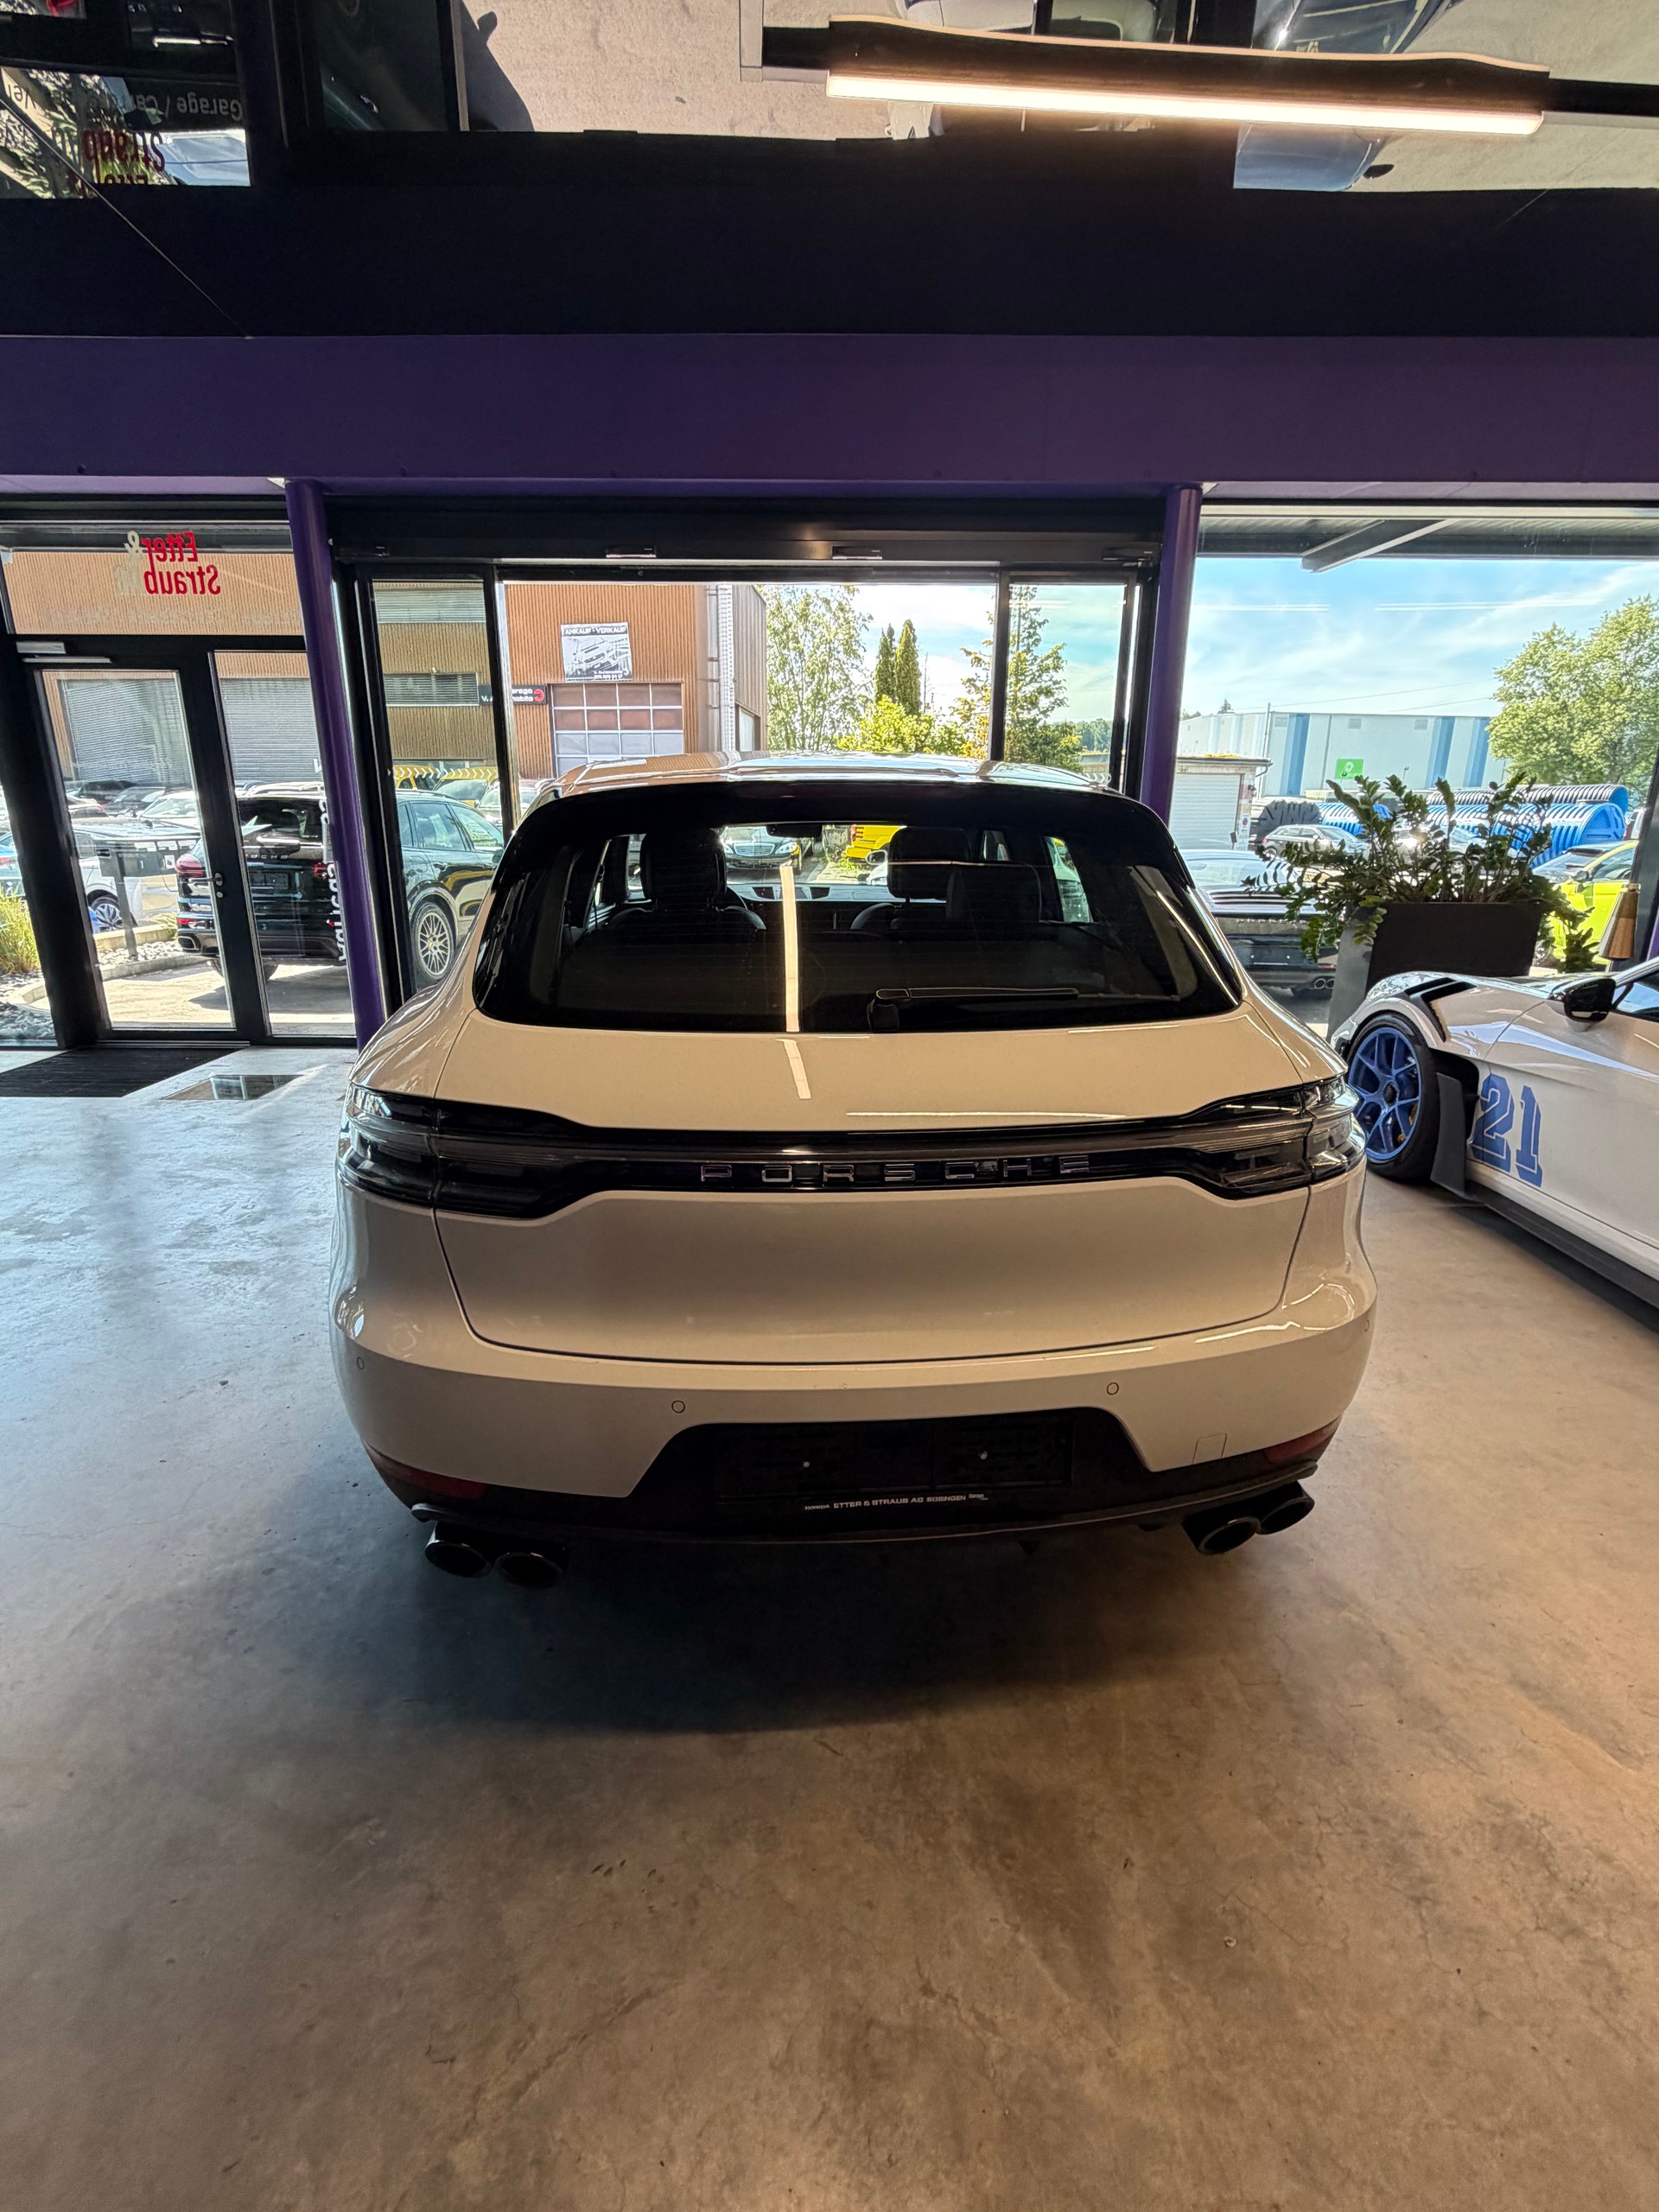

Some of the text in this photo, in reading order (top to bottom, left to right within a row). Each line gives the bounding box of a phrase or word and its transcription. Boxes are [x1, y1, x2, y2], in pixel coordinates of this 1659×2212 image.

[595, 626, 626, 634] VERKAUF
[1471, 1073, 1543, 1188] 21
[701, 1154, 1090, 1183] PORSCHE
[871, 1497, 909, 1506] STRAUB
